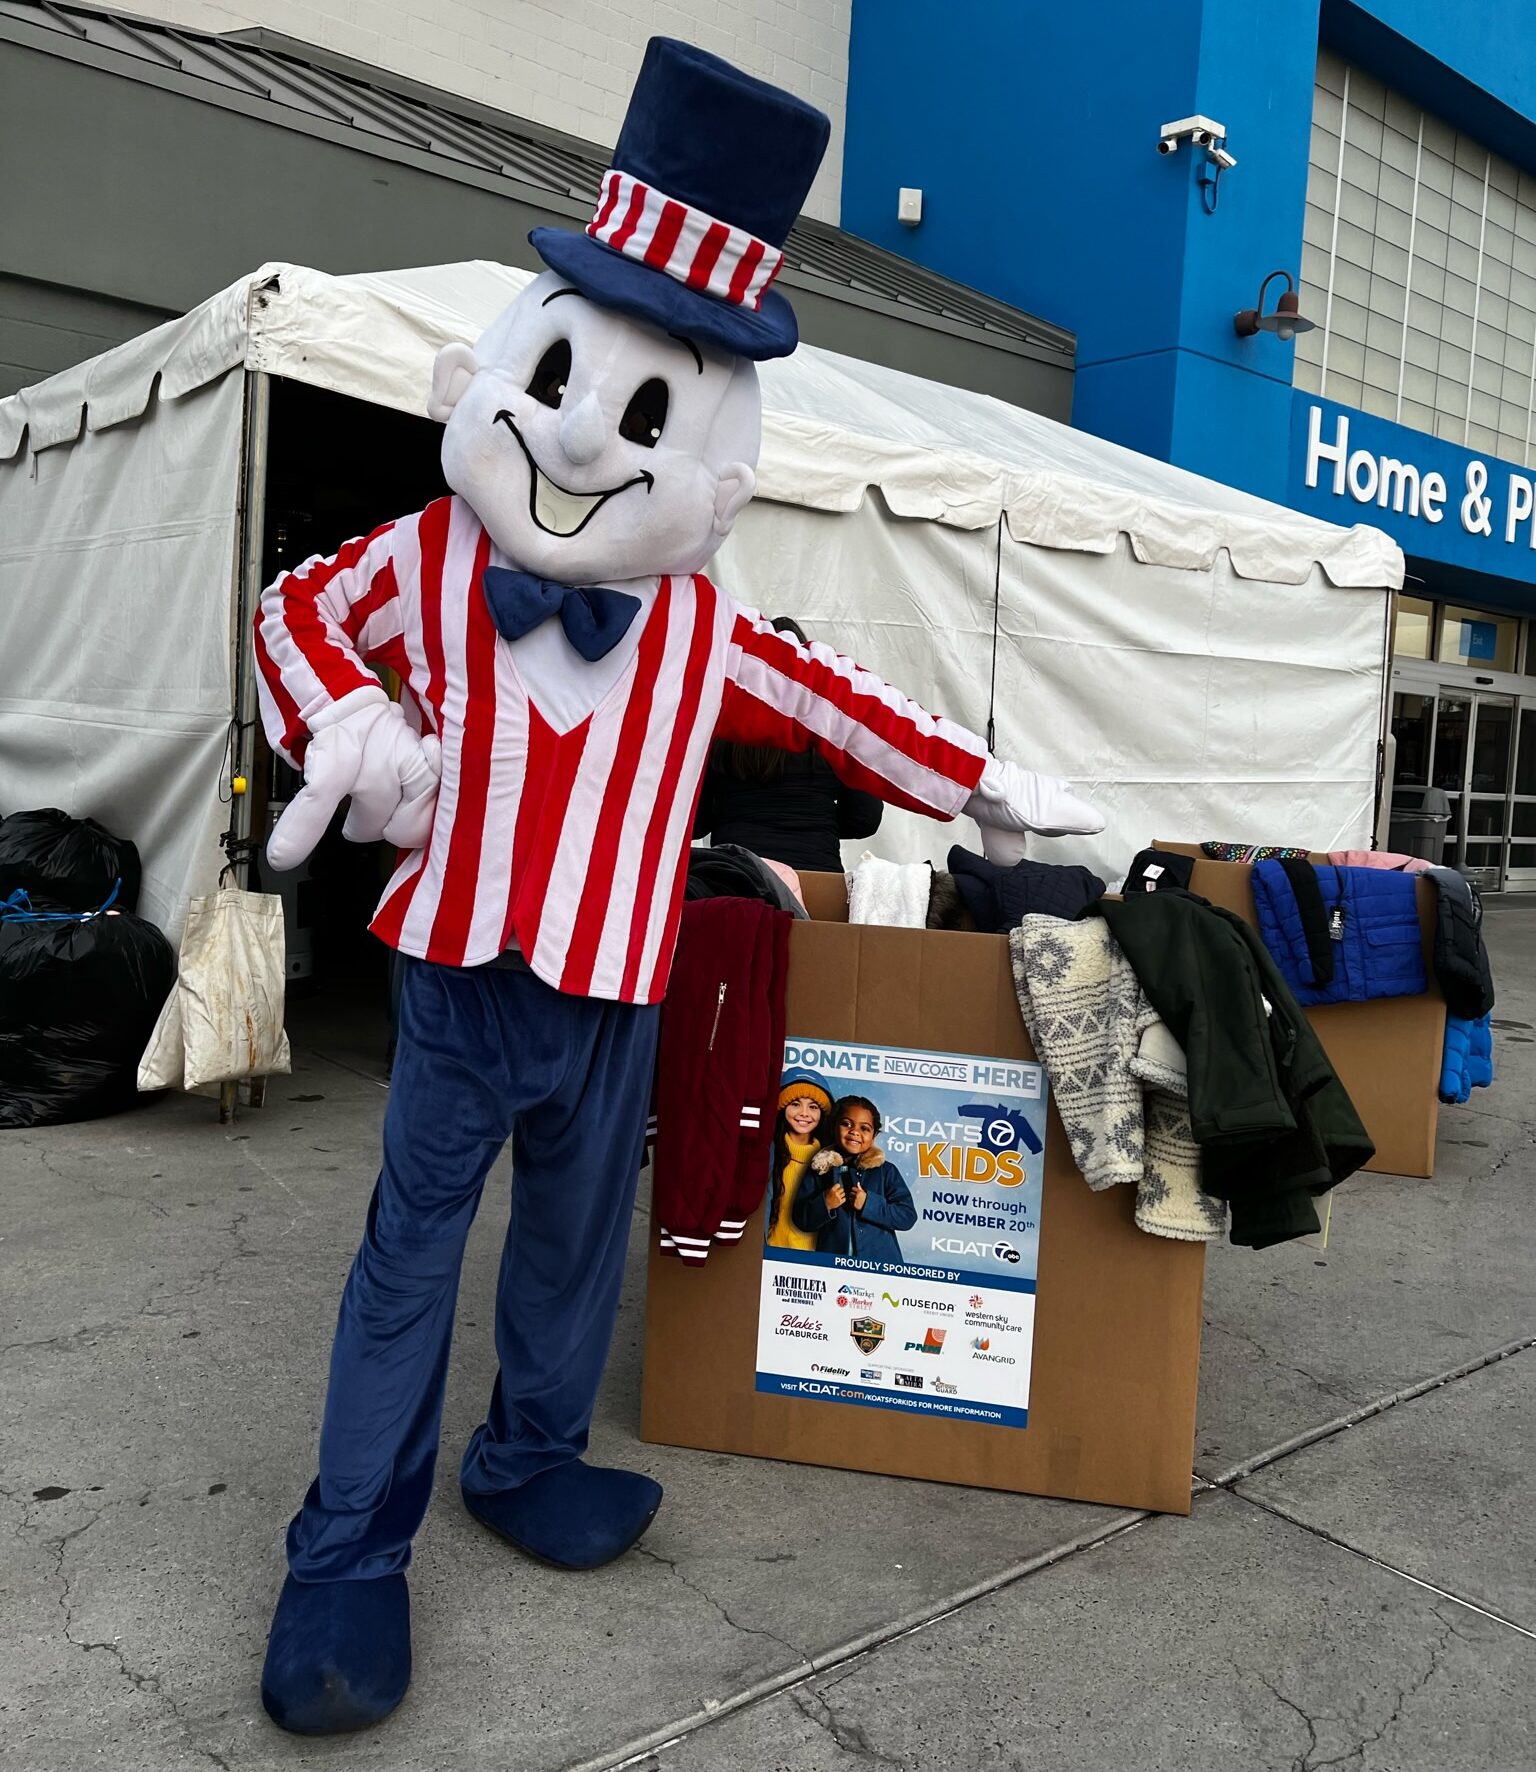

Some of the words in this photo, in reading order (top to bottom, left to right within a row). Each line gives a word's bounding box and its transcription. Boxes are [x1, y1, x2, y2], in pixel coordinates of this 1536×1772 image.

[1305, 406, 1447, 523] Home
[1461, 461, 1492, 537] &
[785, 1046, 880, 1073] DONATE
[884, 1060, 918, 1074] NEW
[919, 1064, 967, 1079] COATS
[973, 1066, 1036, 1090] HERE
[885, 1116, 982, 1143] KOATS
[887, 1137, 913, 1153] for
[917, 1142, 1025, 1188] KIDS
[932, 1191, 969, 1206] NOW
[972, 1197, 1026, 1215] through
[923, 1209, 1005, 1230] NOVEMBER
[1009, 1220, 1035, 1232] 20th
[931, 1236, 992, 1257] KOAT
[834, 1257, 881, 1271] PROUDLY
[883, 1263, 946, 1279] SPONSORED
[947, 1271, 960, 1281] BY
[772, 1275, 827, 1293] ARCHULETA
[776, 1287, 822, 1301] RESTORATION
[852, 1289, 875, 1299] Market
[902, 1297, 955, 1312] NUSENDA
[780, 1314, 823, 1331] Blake's
[965, 1311, 994, 1322] western
[995, 1314, 1009, 1324] sky
[965, 1318, 1005, 1332] community
[1006, 1325, 1023, 1333] care
[775, 1328, 829, 1341] LOTABURGER
[904, 1342, 942, 1355] PNM
[972, 1352, 1016, 1365] AVANGRID
[820, 1365, 850, 1376] Fidelity
[780, 1382, 797, 1391] VISIT
[799, 1381, 917, 1408] KOAT.com/KOATSFORKIDS
[918, 1401, 932, 1410] FOR
[933, 1403, 952, 1412] MORE
[953, 1406, 1001, 1419] INFORMATION
